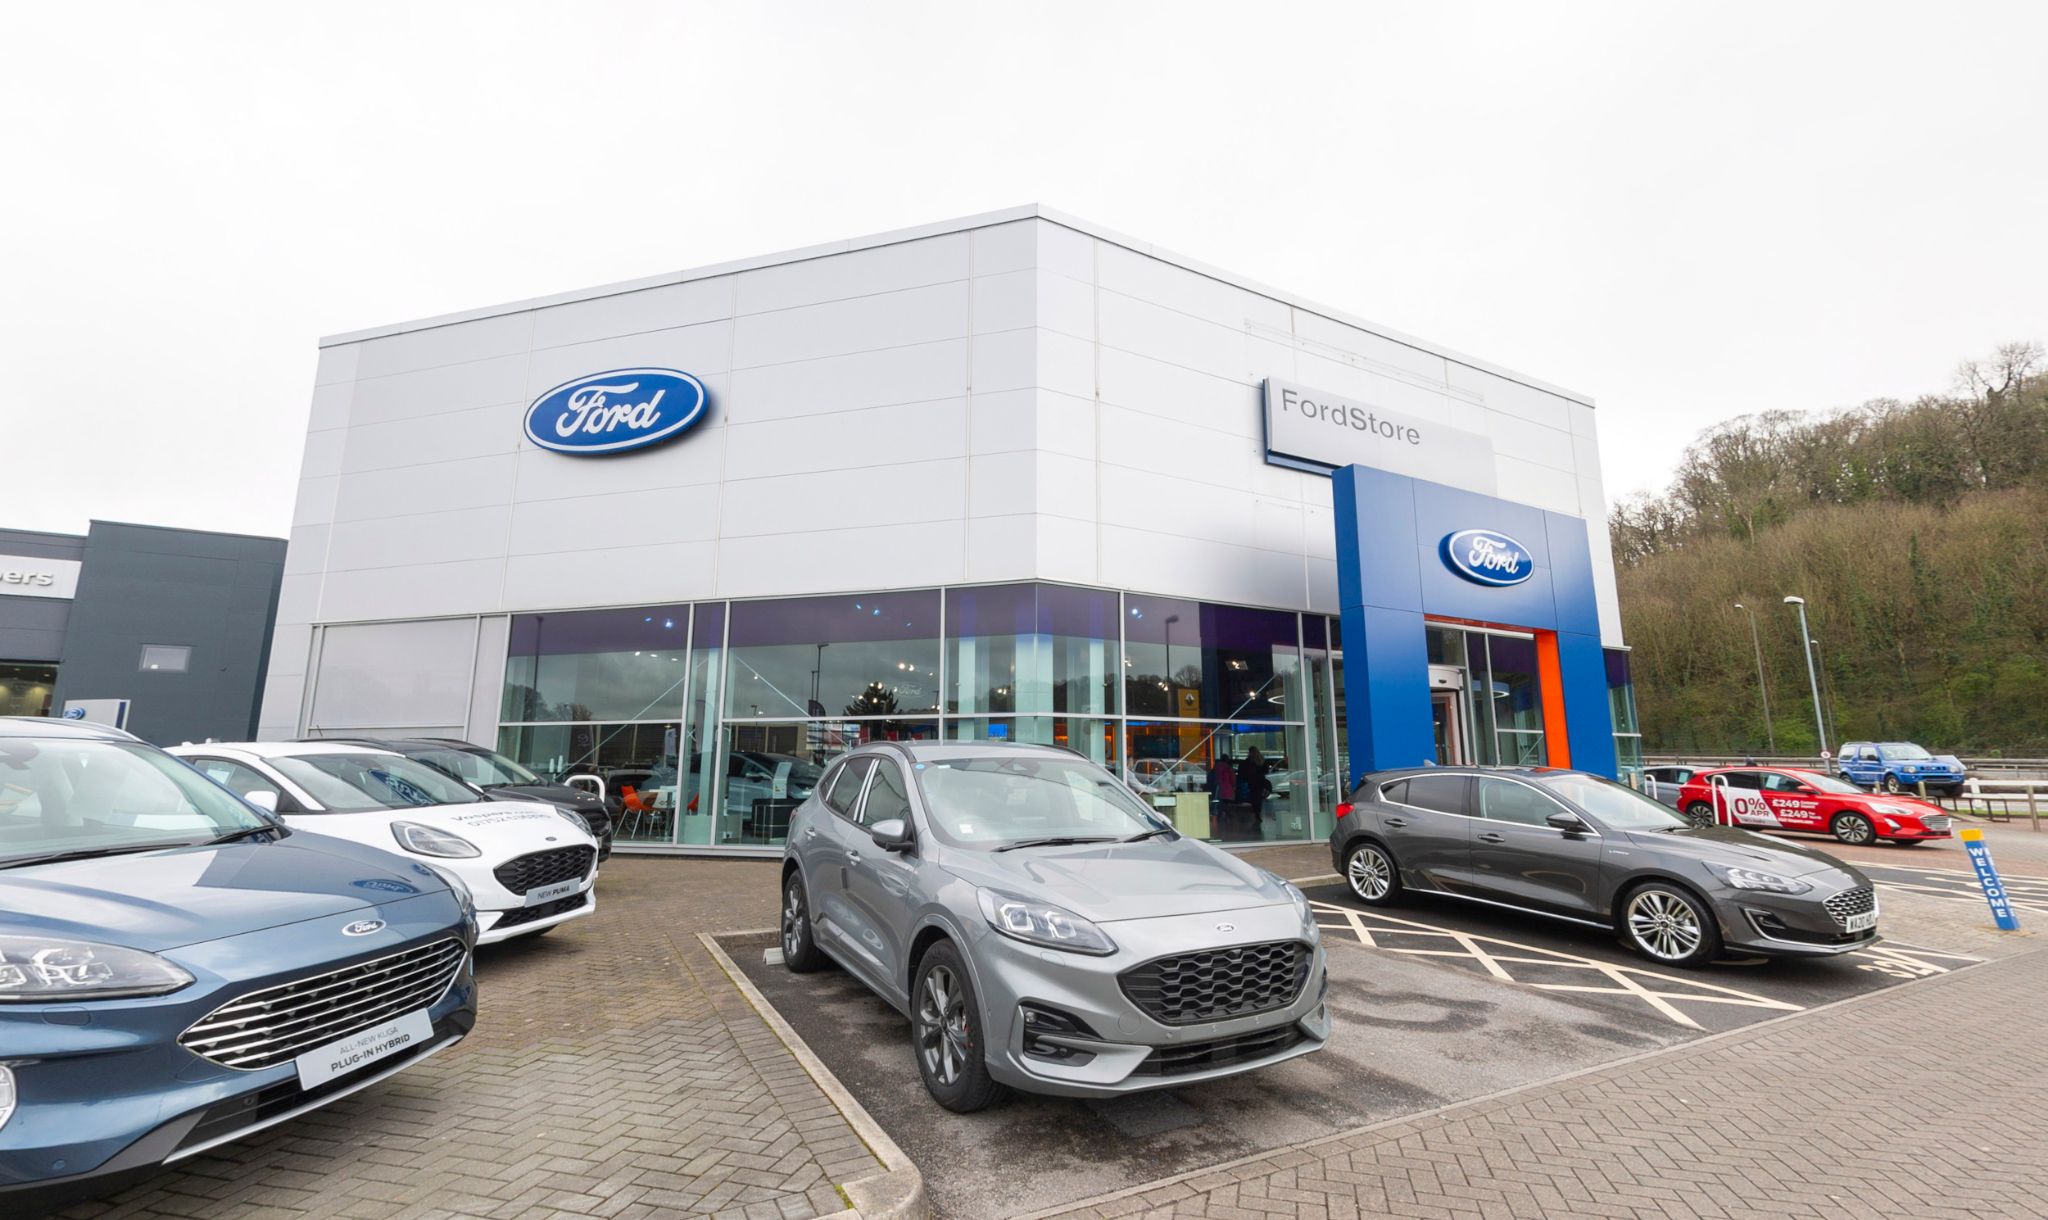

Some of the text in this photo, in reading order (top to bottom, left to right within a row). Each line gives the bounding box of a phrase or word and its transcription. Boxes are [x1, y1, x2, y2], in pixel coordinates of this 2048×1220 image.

[555, 382, 666, 438] Ford
[1281, 387, 1421, 446] FordStore
[1468, 536, 1520, 574] Ford
[0, 570, 54, 587] ers
[1734, 797, 1766, 815] 0%
[1772, 799, 1800, 808] £249
[1750, 809, 1770, 817] APR
[1780, 809, 1808, 819] £249
[552, 885, 570, 896] PUMA
[1968, 847, 2009, 918] WELCOME
[354, 920, 378, 933] Ford
[339, 1026, 399, 1055] ALL-NEW KUGA
[330, 1033, 411, 1072] PLUG-IN HYBRID
